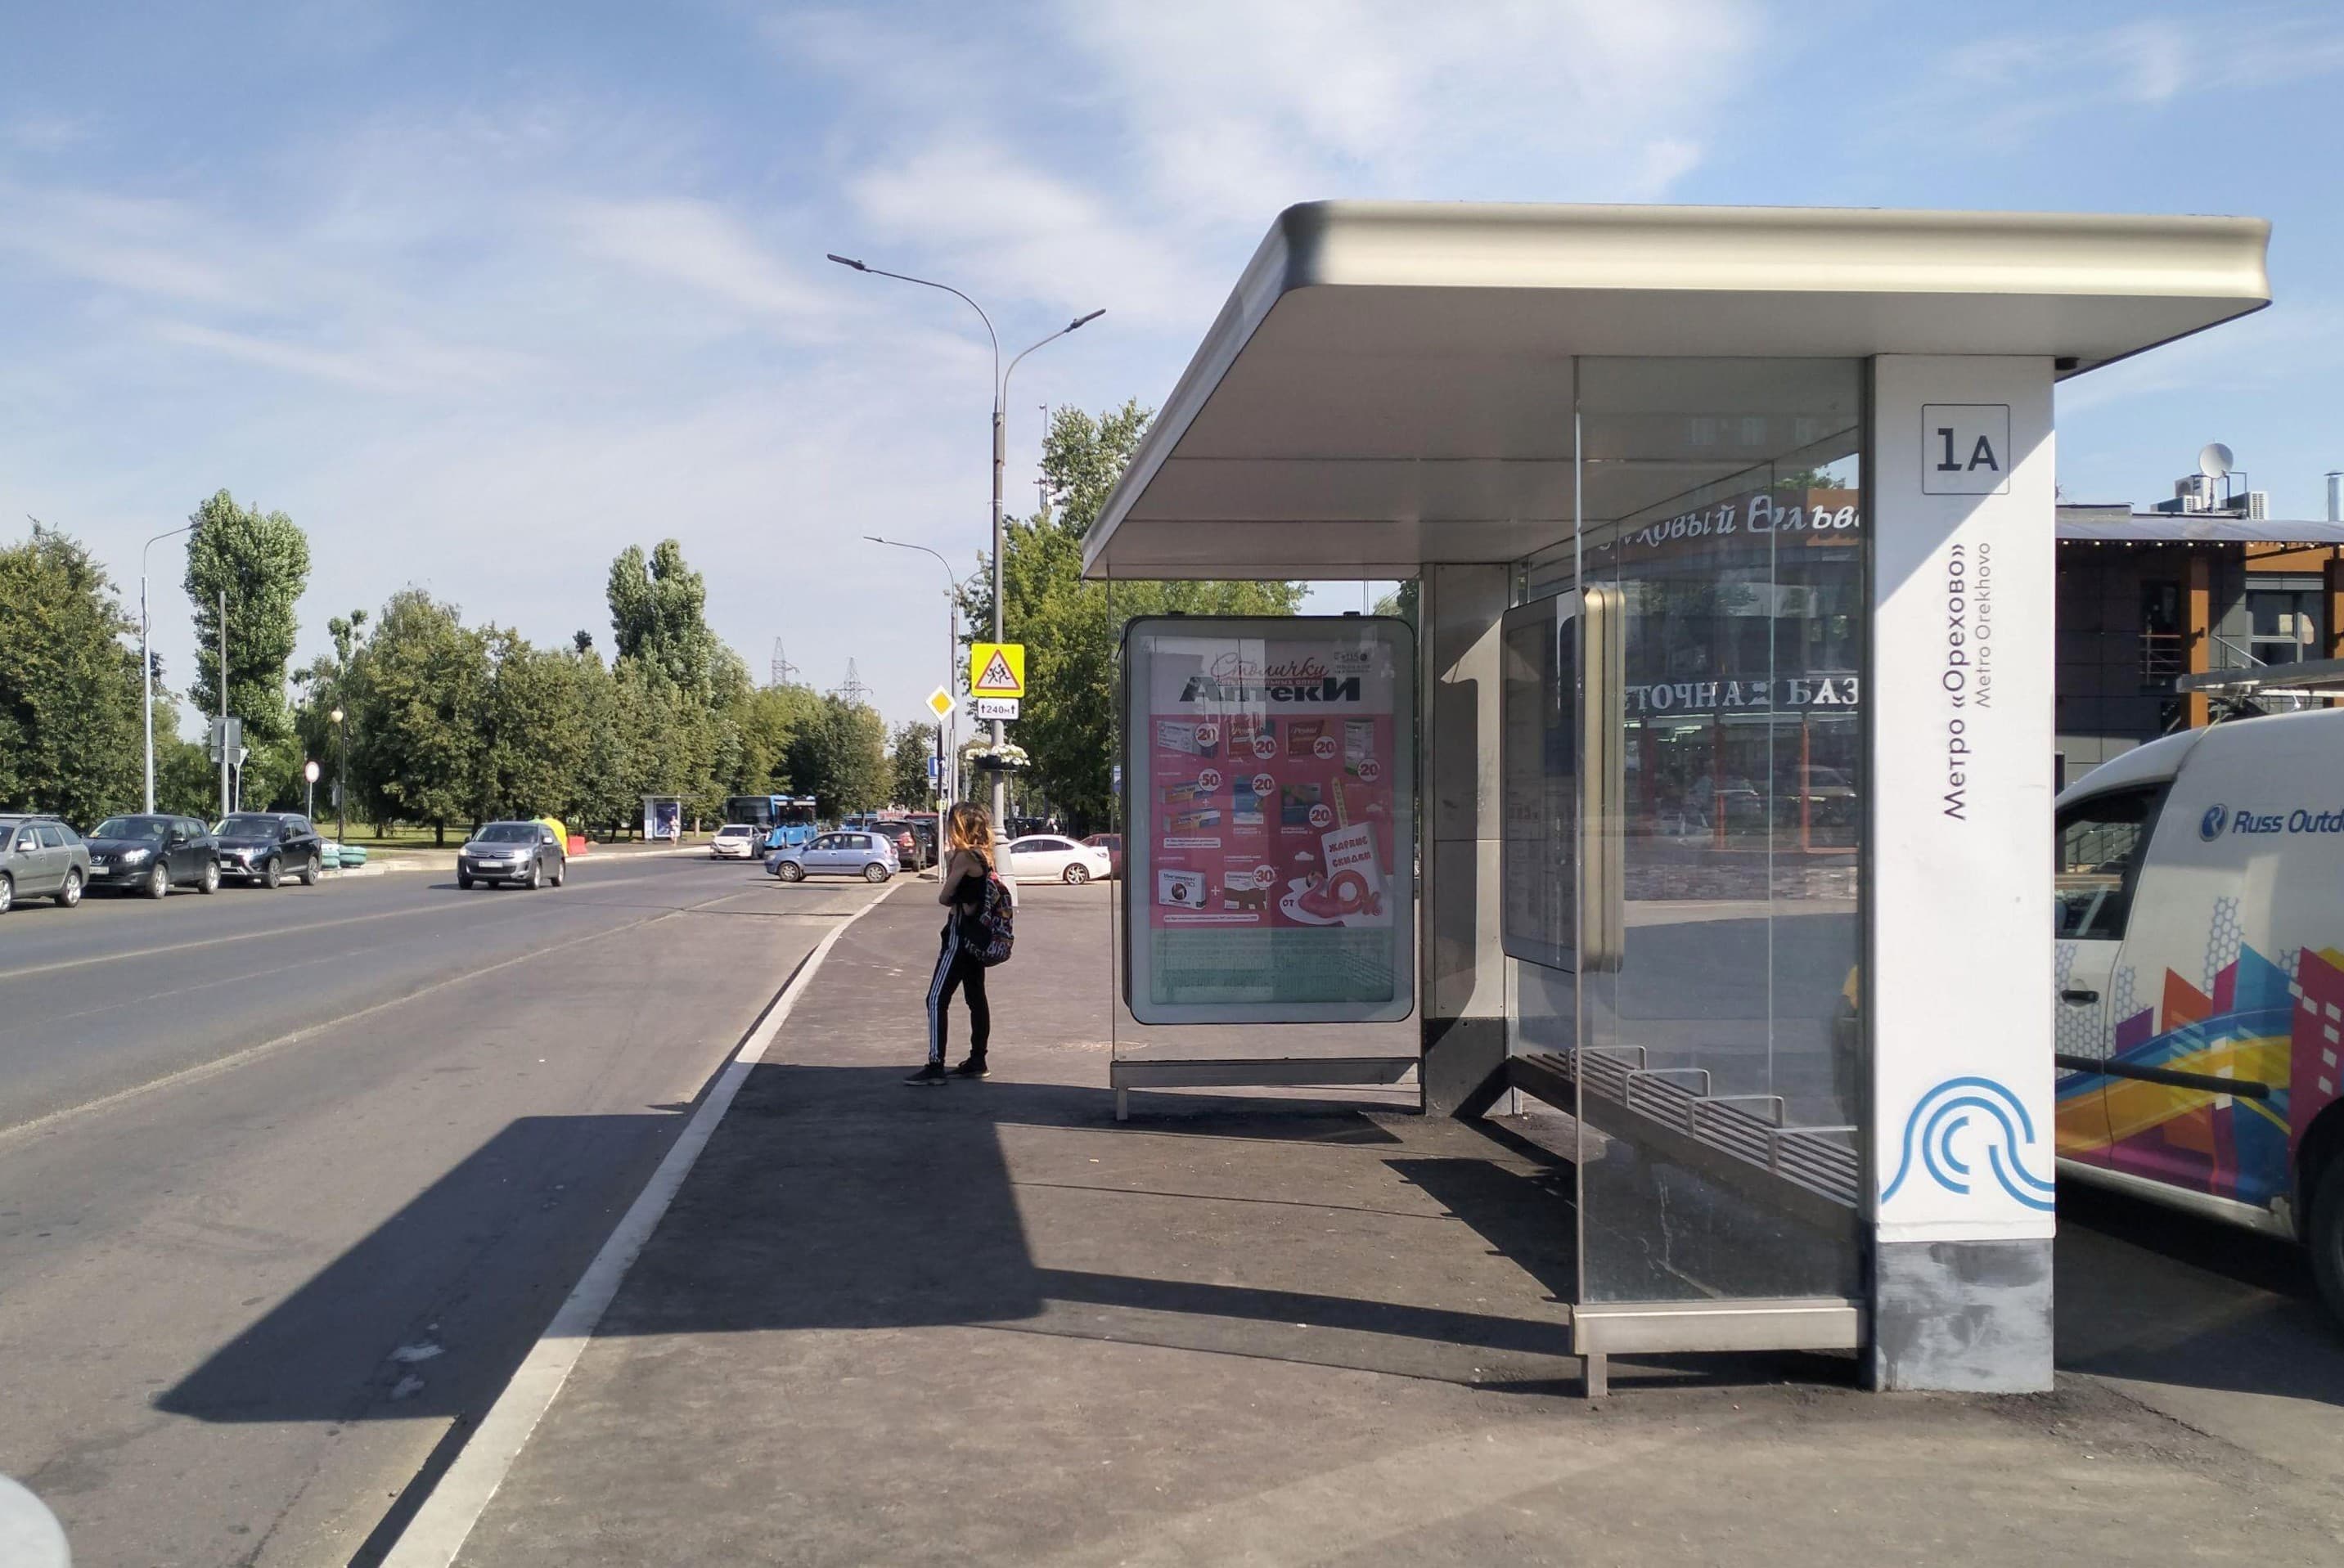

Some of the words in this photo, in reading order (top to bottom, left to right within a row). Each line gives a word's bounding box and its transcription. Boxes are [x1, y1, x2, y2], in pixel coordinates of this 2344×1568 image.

[1943, 543, 1971, 708] «Орехово»
[1974, 542, 1991, 640] Orekhovo
[1975, 646, 1991, 708] Metro
[1943, 719, 1971, 820] Метро
[2232, 811, 2285, 833] Russ
[2288, 808, 2344, 833] Outd
